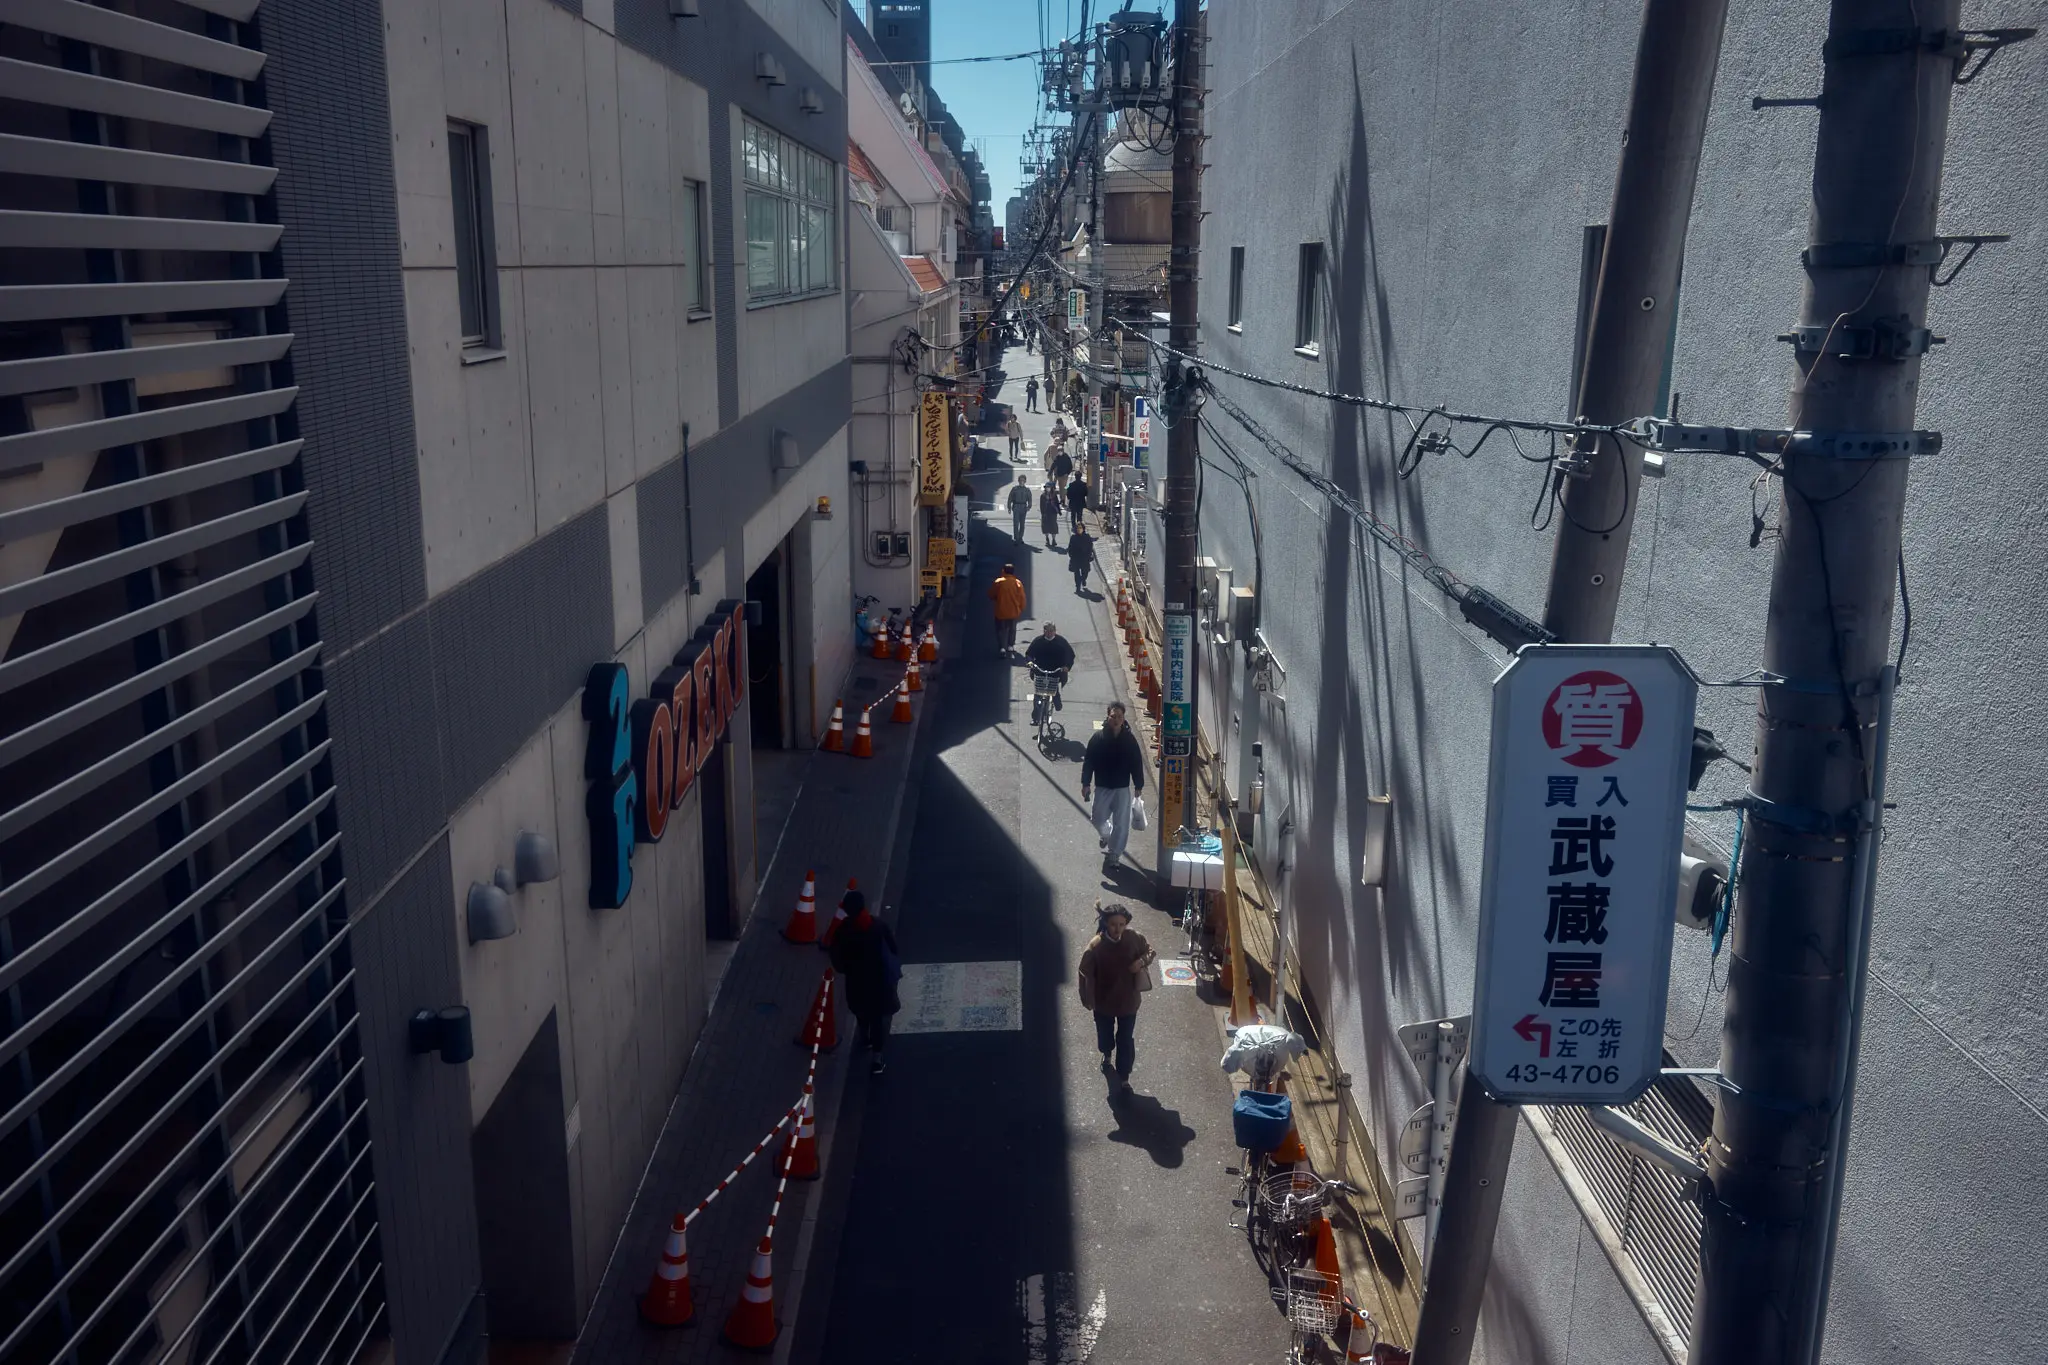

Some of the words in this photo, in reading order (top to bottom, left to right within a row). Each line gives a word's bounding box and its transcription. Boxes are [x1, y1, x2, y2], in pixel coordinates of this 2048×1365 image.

[646, 602, 744, 839] OZEKI
[1553, 683, 1633, 757] 質
[1545, 776, 1629, 808] 買入
[1538, 815, 1617, 1009] 武蔵屋
[1558, 1018, 1622, 1037] この先
[1556, 1039, 1620, 1059] 左折
[1506, 1064, 1620, 1085] 43-4706
